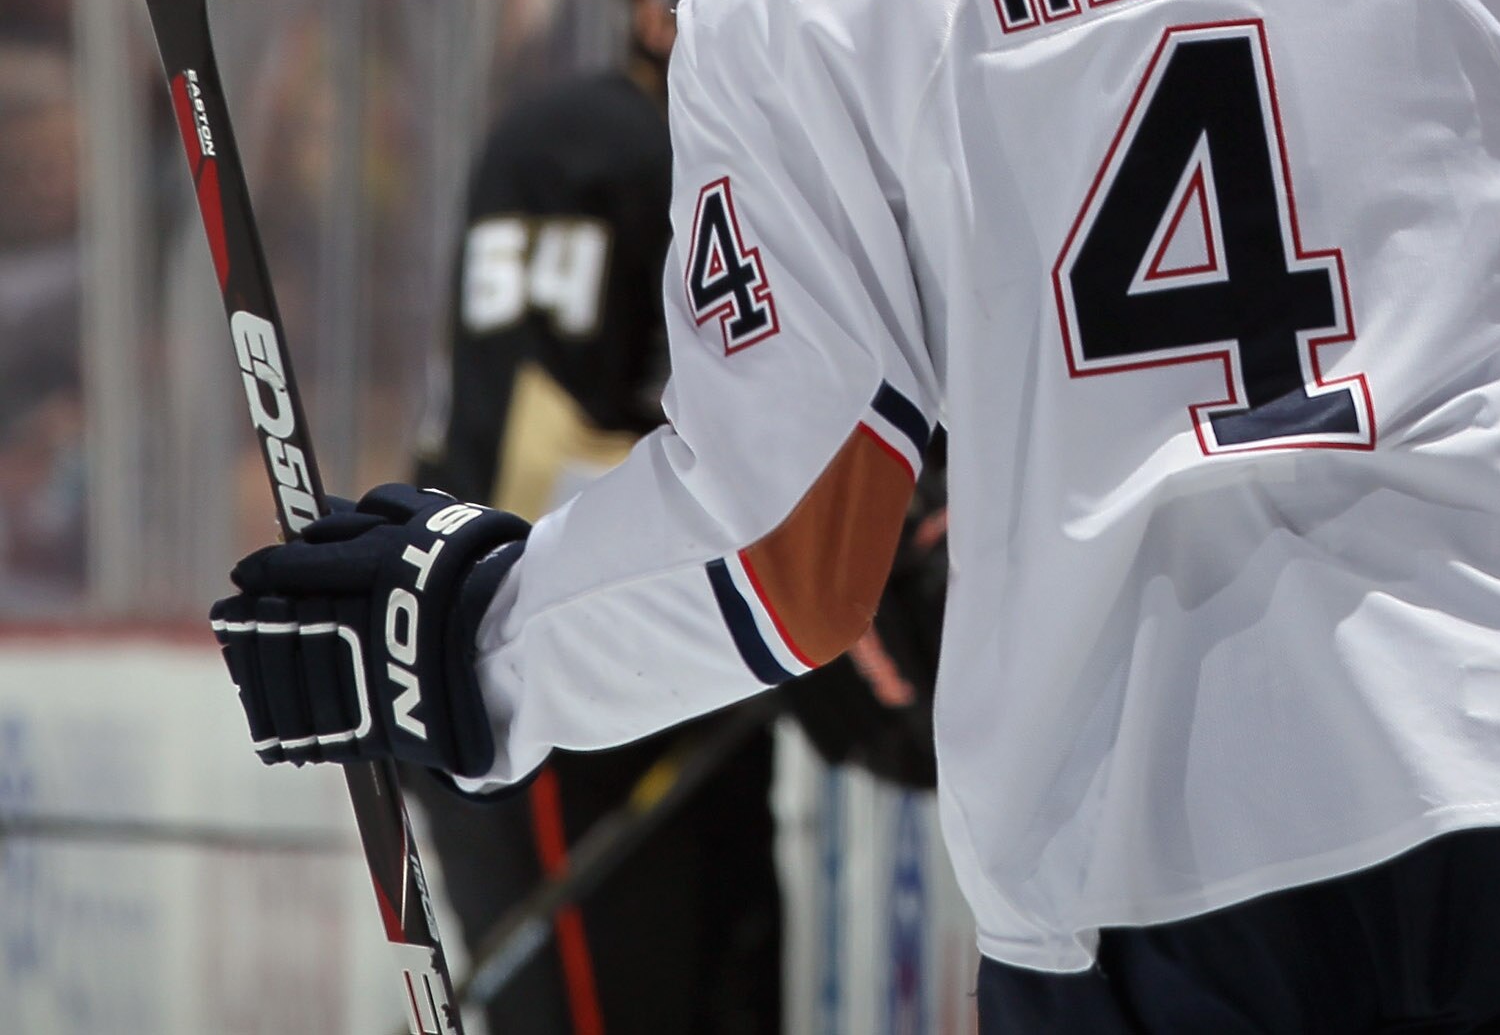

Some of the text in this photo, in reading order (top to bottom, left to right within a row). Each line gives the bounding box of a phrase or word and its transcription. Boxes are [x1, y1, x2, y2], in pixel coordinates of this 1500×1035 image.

[187, 68, 216, 156] EASTON
[685, 176, 780, 357] 4
[1052, 18, 1377, 456] 4
[384, 490, 492, 740] STON
